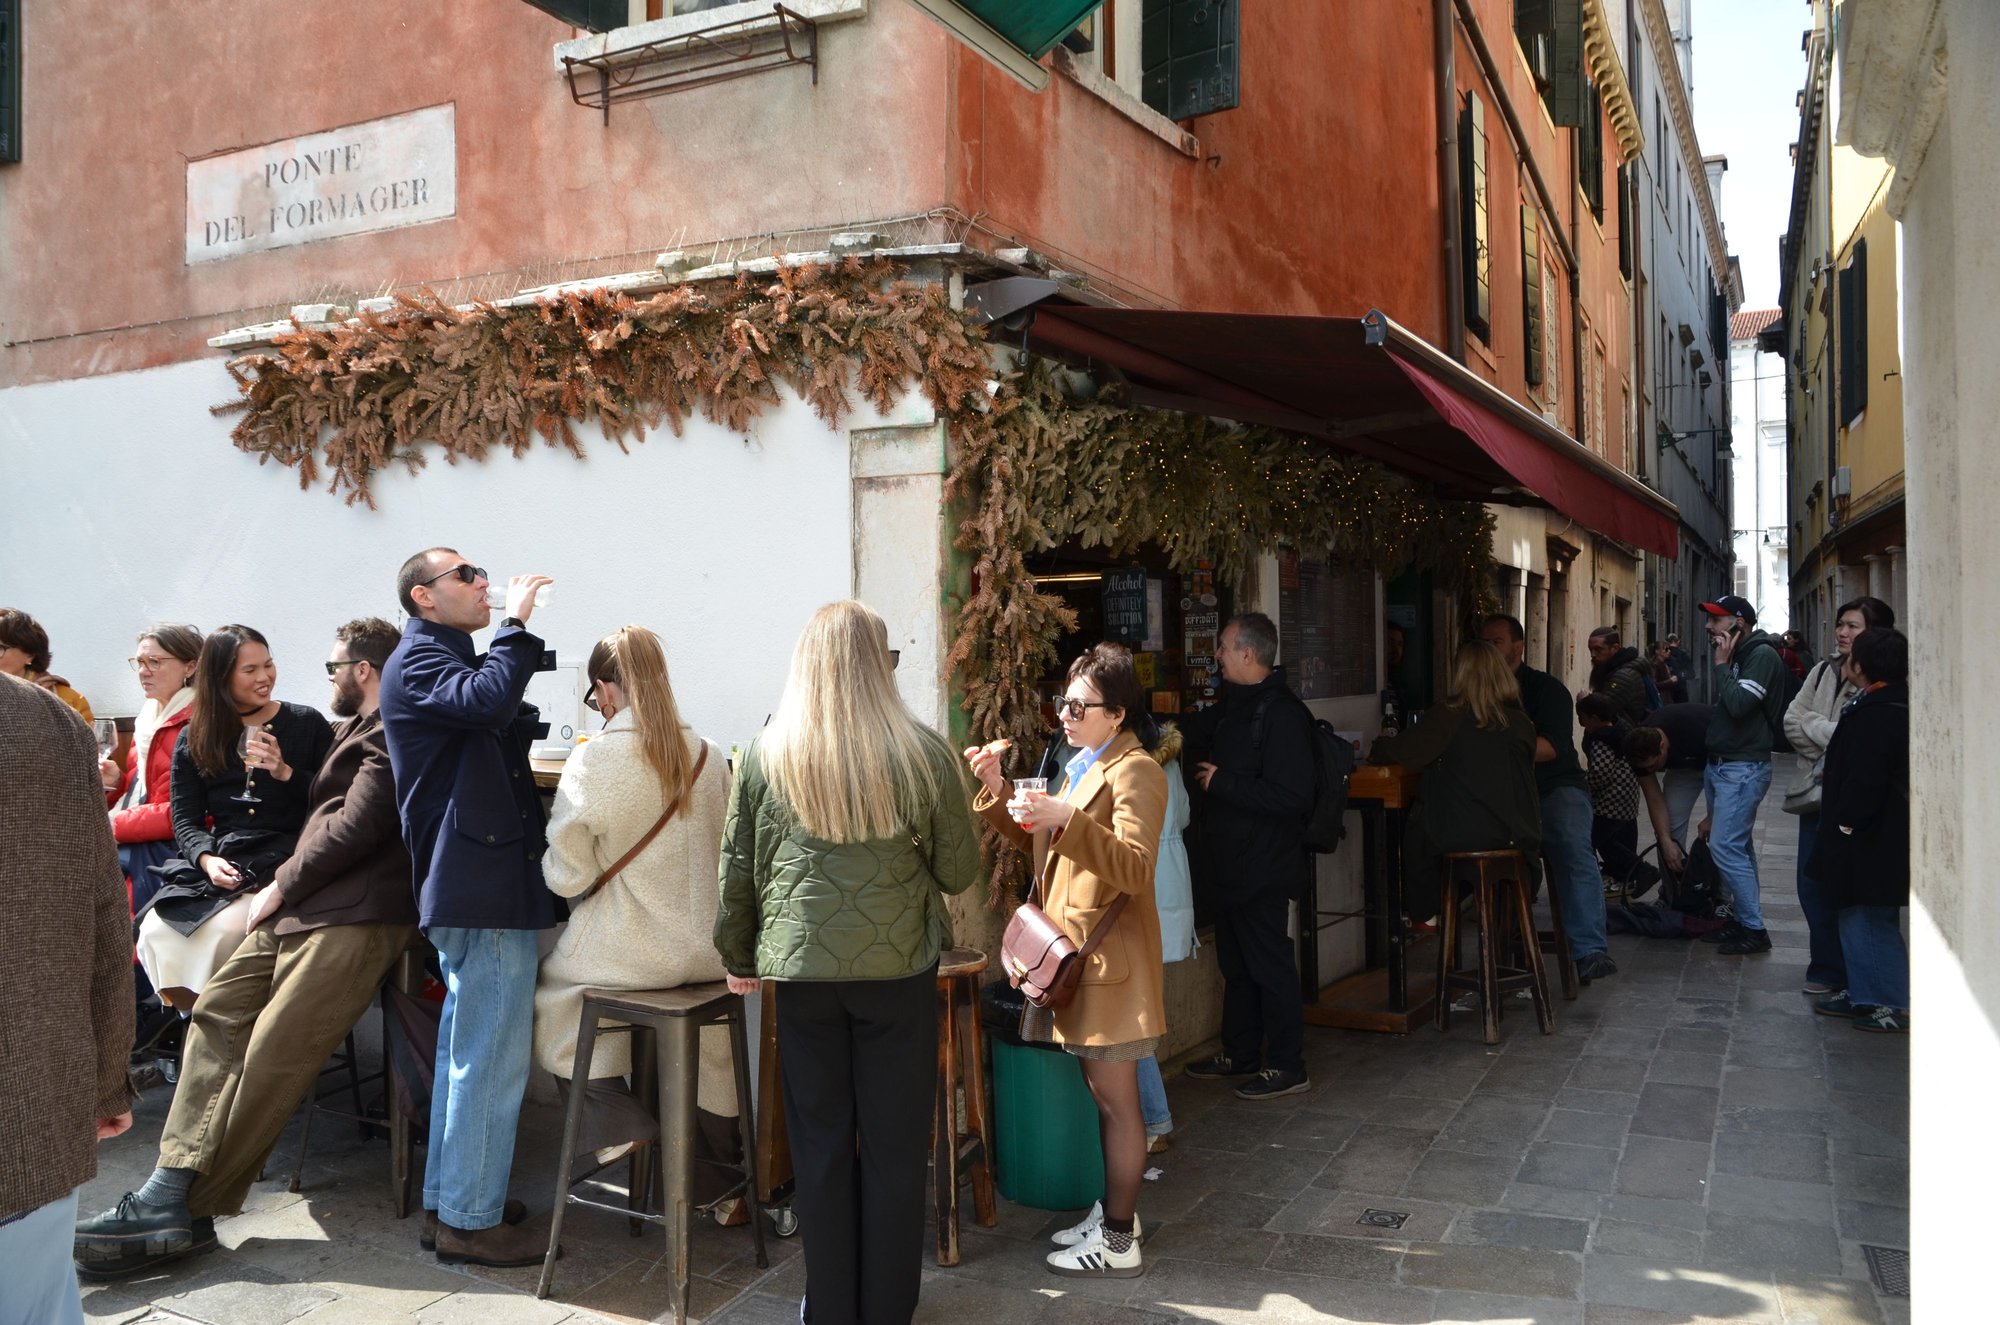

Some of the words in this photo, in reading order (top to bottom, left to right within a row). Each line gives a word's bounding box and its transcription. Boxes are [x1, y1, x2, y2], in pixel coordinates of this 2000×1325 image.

[265, 143, 361, 188] PONTE
[205, 215, 256, 246] DEL
[269, 177, 429, 233] FORMAGER
[1105, 573, 1143, 595] Alcohol
[1107, 595, 1142, 611] DEFINITELY
[1107, 611, 1143, 625] SOLUTION
